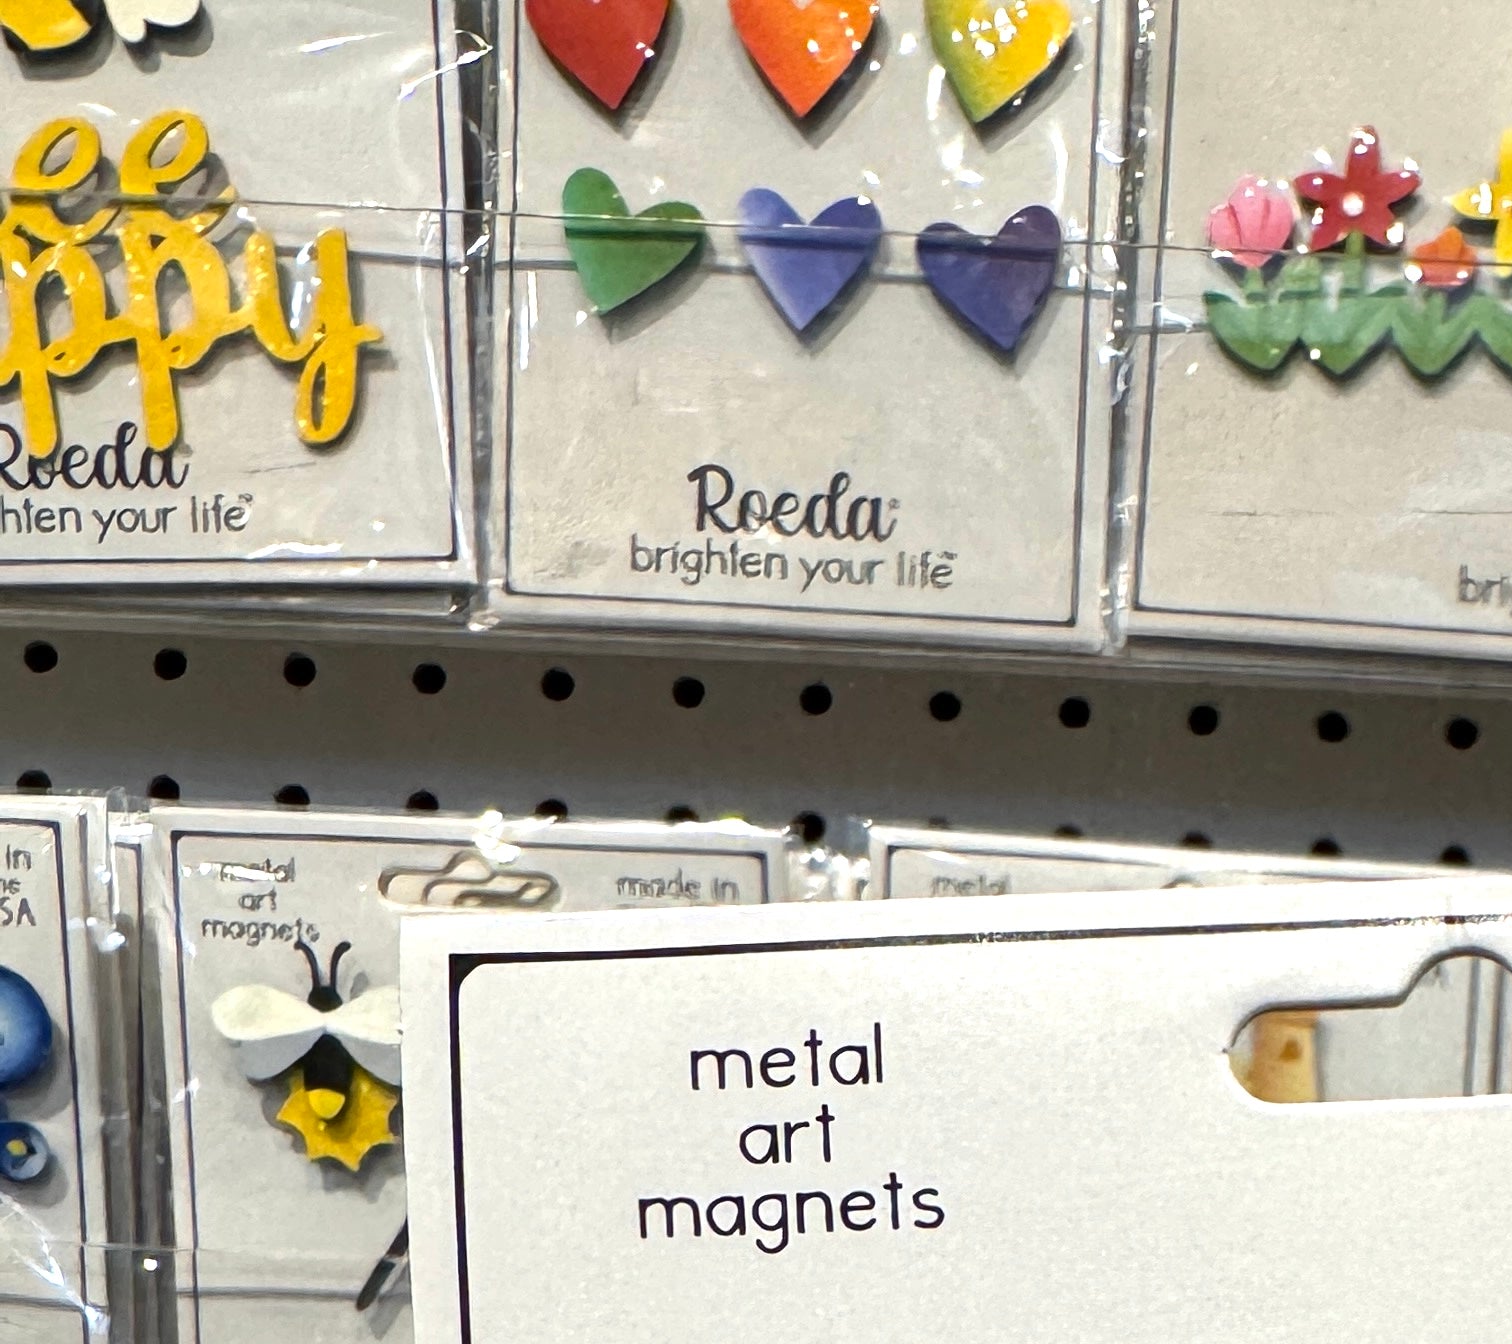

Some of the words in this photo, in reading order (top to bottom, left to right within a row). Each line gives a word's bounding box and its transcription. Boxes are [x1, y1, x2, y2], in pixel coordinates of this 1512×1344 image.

[8, 109, 239, 246] ee
[0, 227, 384, 459] ppy
[0, 496, 82, 535] hten
[93, 506, 178, 544] your
[631, 533, 788, 586] brighten
[798, 554, 885, 594] your
[0, 896, 36, 927] SA
[690, 1022, 884, 1091] metal
[738, 1103, 836, 1164] art
[637, 1172, 946, 1255] magnets
